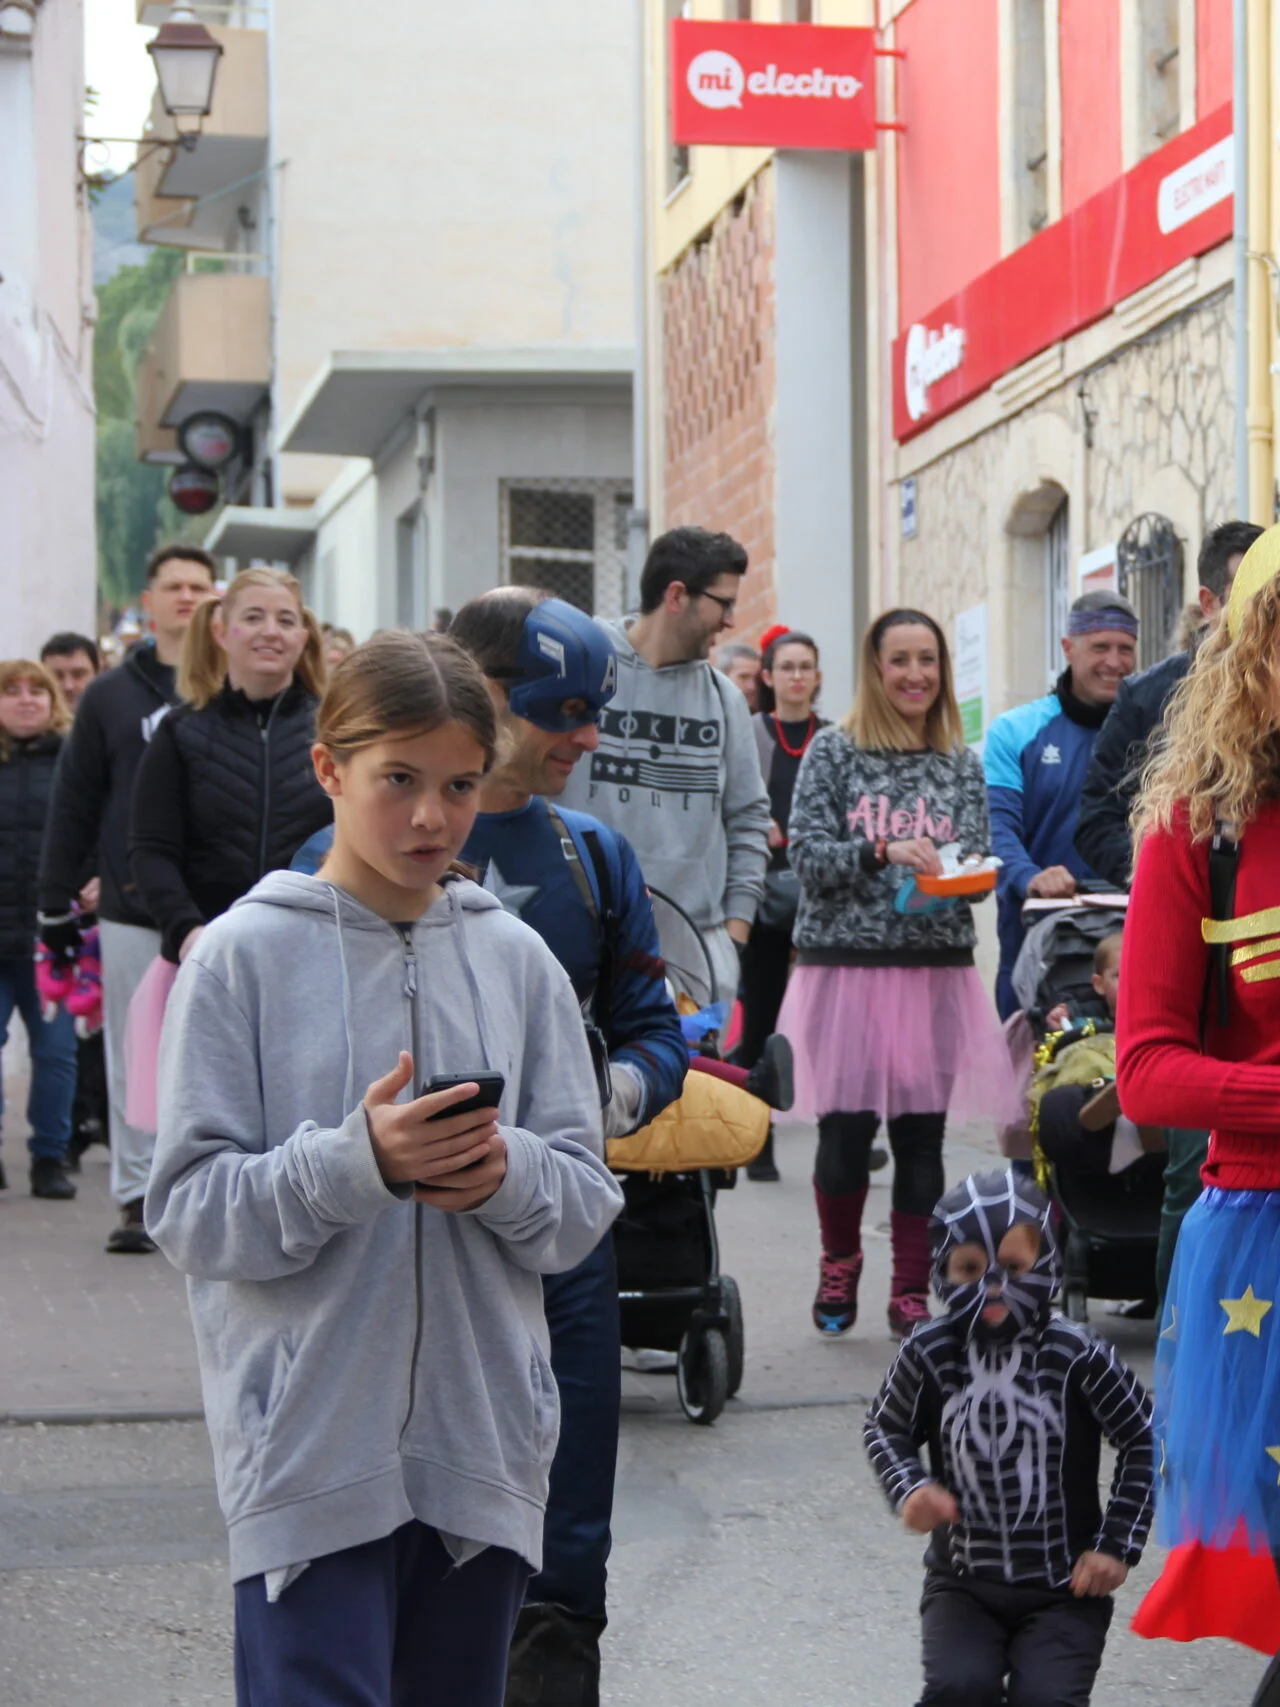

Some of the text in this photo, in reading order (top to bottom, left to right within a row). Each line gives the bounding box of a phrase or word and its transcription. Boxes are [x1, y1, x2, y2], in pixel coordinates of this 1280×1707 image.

[698, 63, 863, 100] mi electro
[600, 709, 718, 744] TOKYO
[846, 793, 958, 842] Aloha
